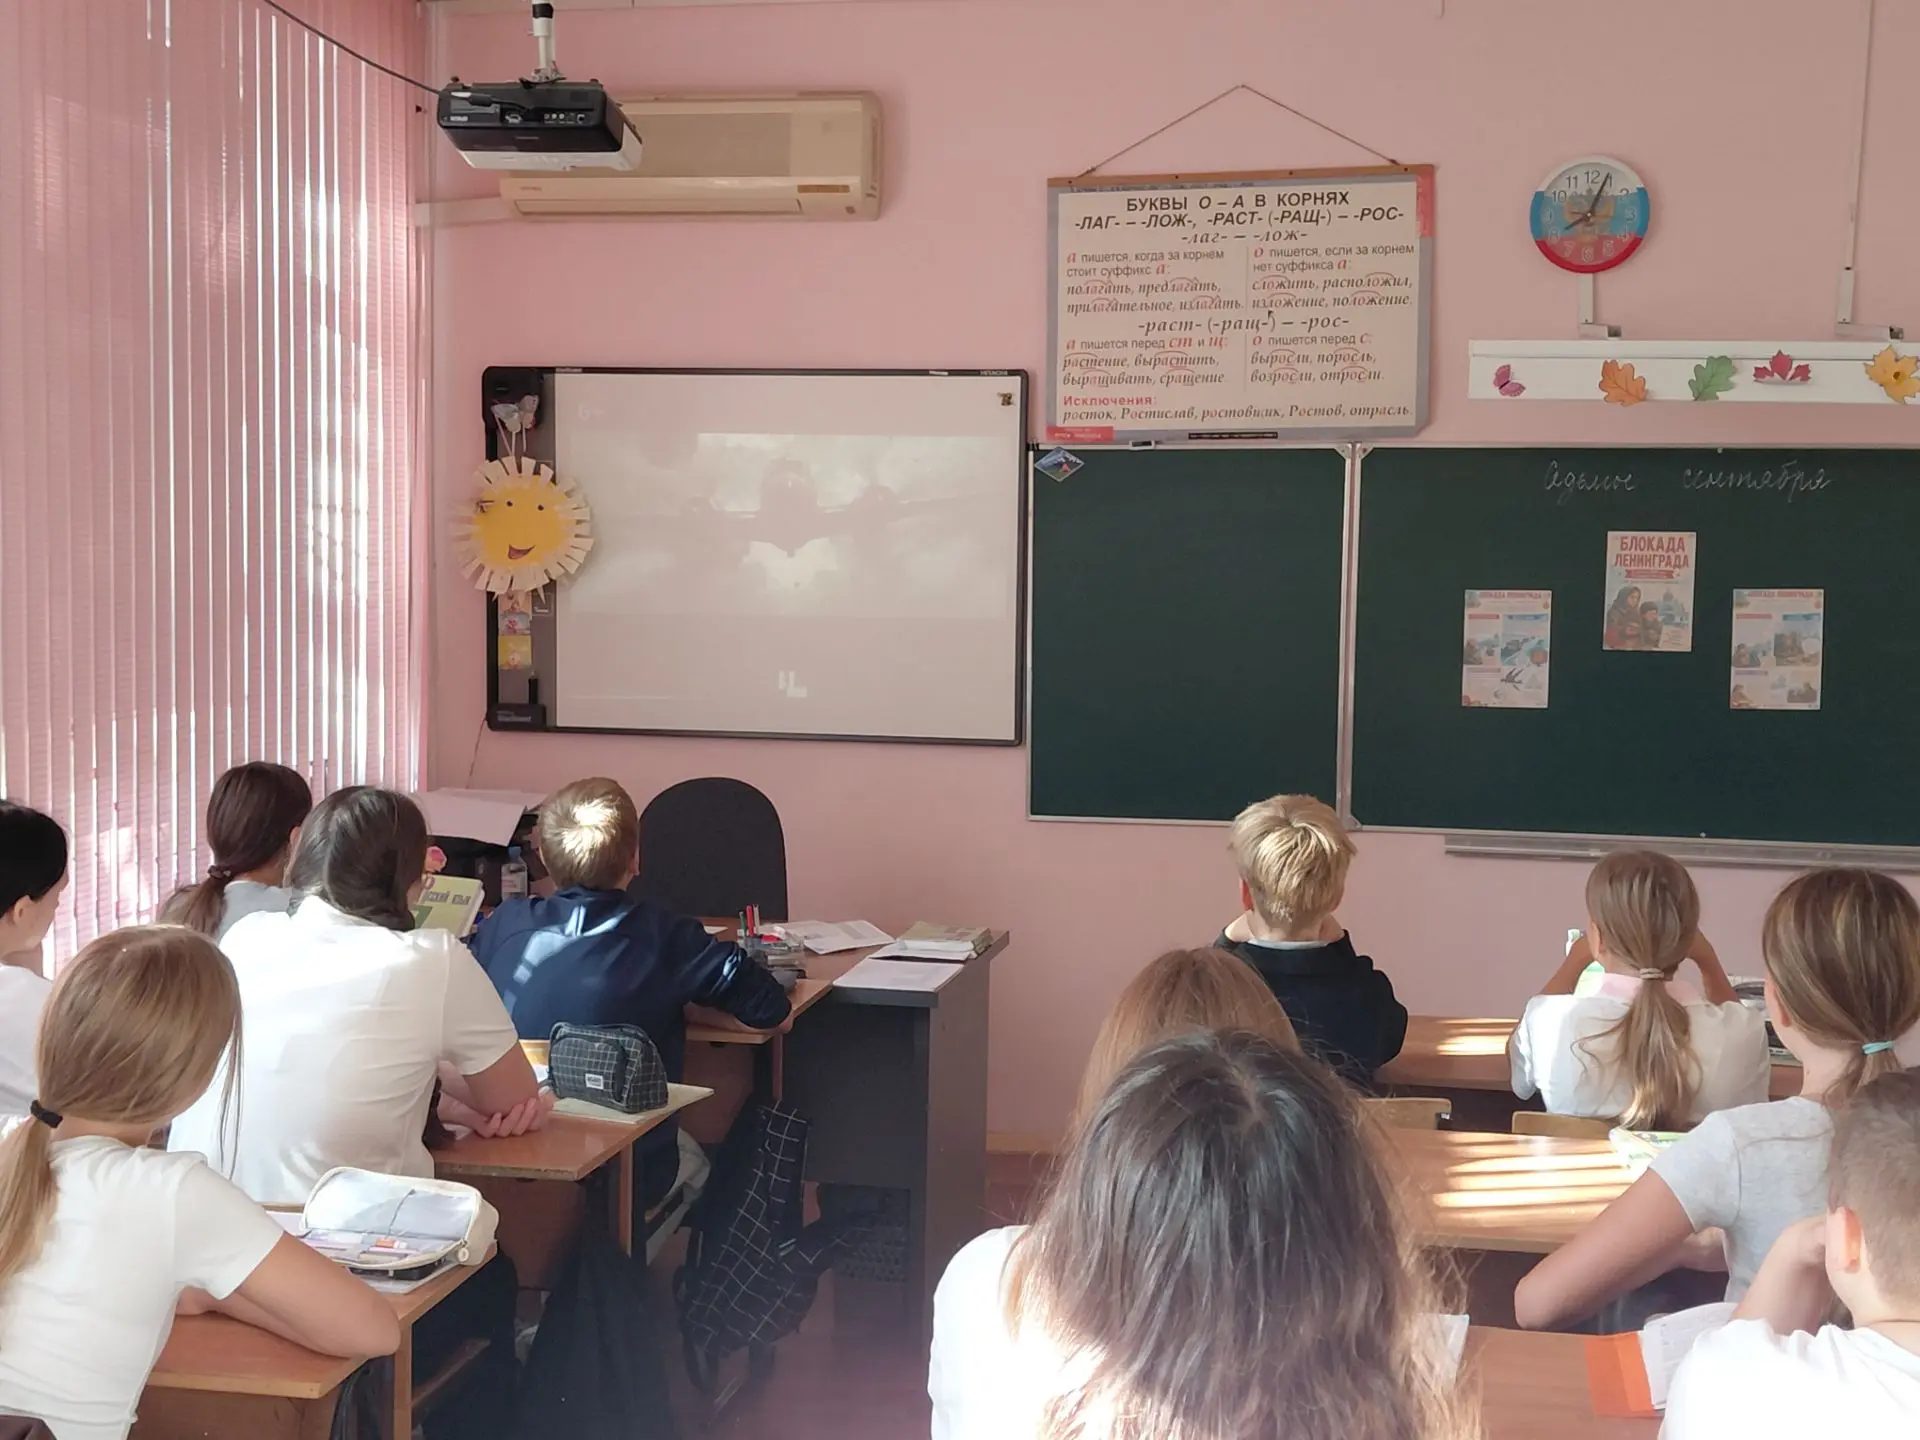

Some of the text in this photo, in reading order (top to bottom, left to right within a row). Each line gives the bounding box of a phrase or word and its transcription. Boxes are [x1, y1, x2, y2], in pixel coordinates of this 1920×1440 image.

[1566, 176, 1578, 188] 11
[1584, 170, 1600, 185] 12
[1126, 196, 1188, 212] БУКВЫ
[1199, 195, 1211, 209] О
[1232, 195, 1244, 208] А
[1255, 194, 1266, 207] В
[1277, 191, 1350, 207] КОРНЯХ
[1552, 190, 1567, 203] 10
[1619, 188, 1629, 202] 2
[1075, 215, 1120, 230] -ЛАГ-
[1207, 211, 1263, 226] -РАСТ-
[1354, 206, 1404, 221] -РОС-
[1625, 207, 1637, 223] 3
[1548, 228, 1560, 243] 8
[1617, 226, 1629, 242] 4
[1135, 252, 1164, 262] когда
[1168, 251, 1180, 260] за
[1183, 250, 1224, 262] корнем
[1325, 246, 1352, 256] если
[1355, 246, 1368, 255] за
[1372, 244, 1414, 257] корнем
[1563, 241, 1576, 257] 7
[1582, 246, 1594, 263] 6
[1066, 266, 1097, 277] стоит
[1101, 265, 1151, 279] суффикс
[1253, 262, 1272, 272] нет
[1275, 260, 1334, 273] суффикса
[1080, 339, 1128, 349] пишется
[1131, 338, 1165, 350] перед
[1197, 338, 1204, 347] и
[1268, 335, 1317, 346] пишется
[1320, 334, 1356, 345] перед
[1063, 395, 1157, 407] Исключения:
[1062, 409, 1117, 424] росток,
[1121, 406, 1198, 421] Ростислав,
[1289, 403, 1346, 418] Ростов,
[1620, 535, 1686, 553] БЛОКАДА
[1614, 554, 1690, 569] ЛЕНИНГРАДА
